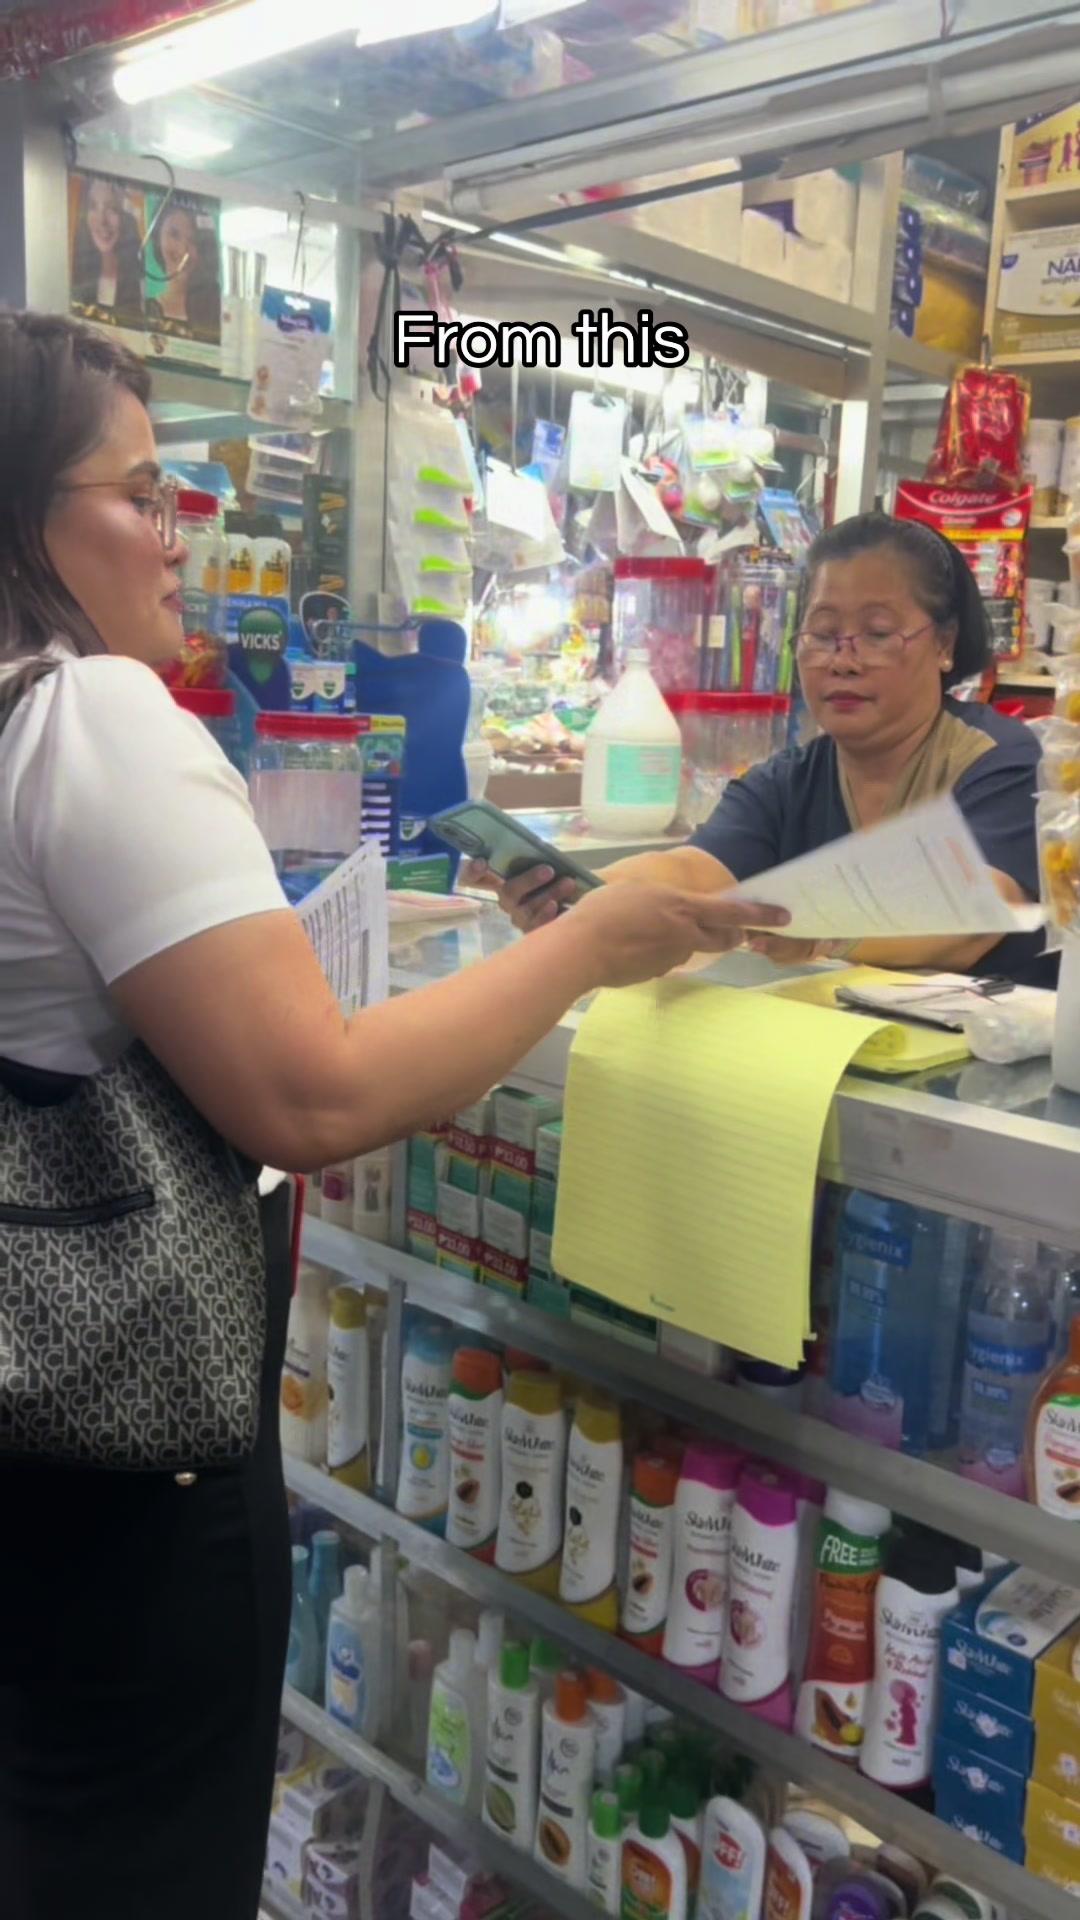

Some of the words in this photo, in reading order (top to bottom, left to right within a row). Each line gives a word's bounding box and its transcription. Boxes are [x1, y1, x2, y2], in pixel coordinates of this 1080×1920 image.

[928, 490, 997, 507] Colgate
[240, 632, 280, 650] VICKS
[820, 1534, 858, 1566] FREE
